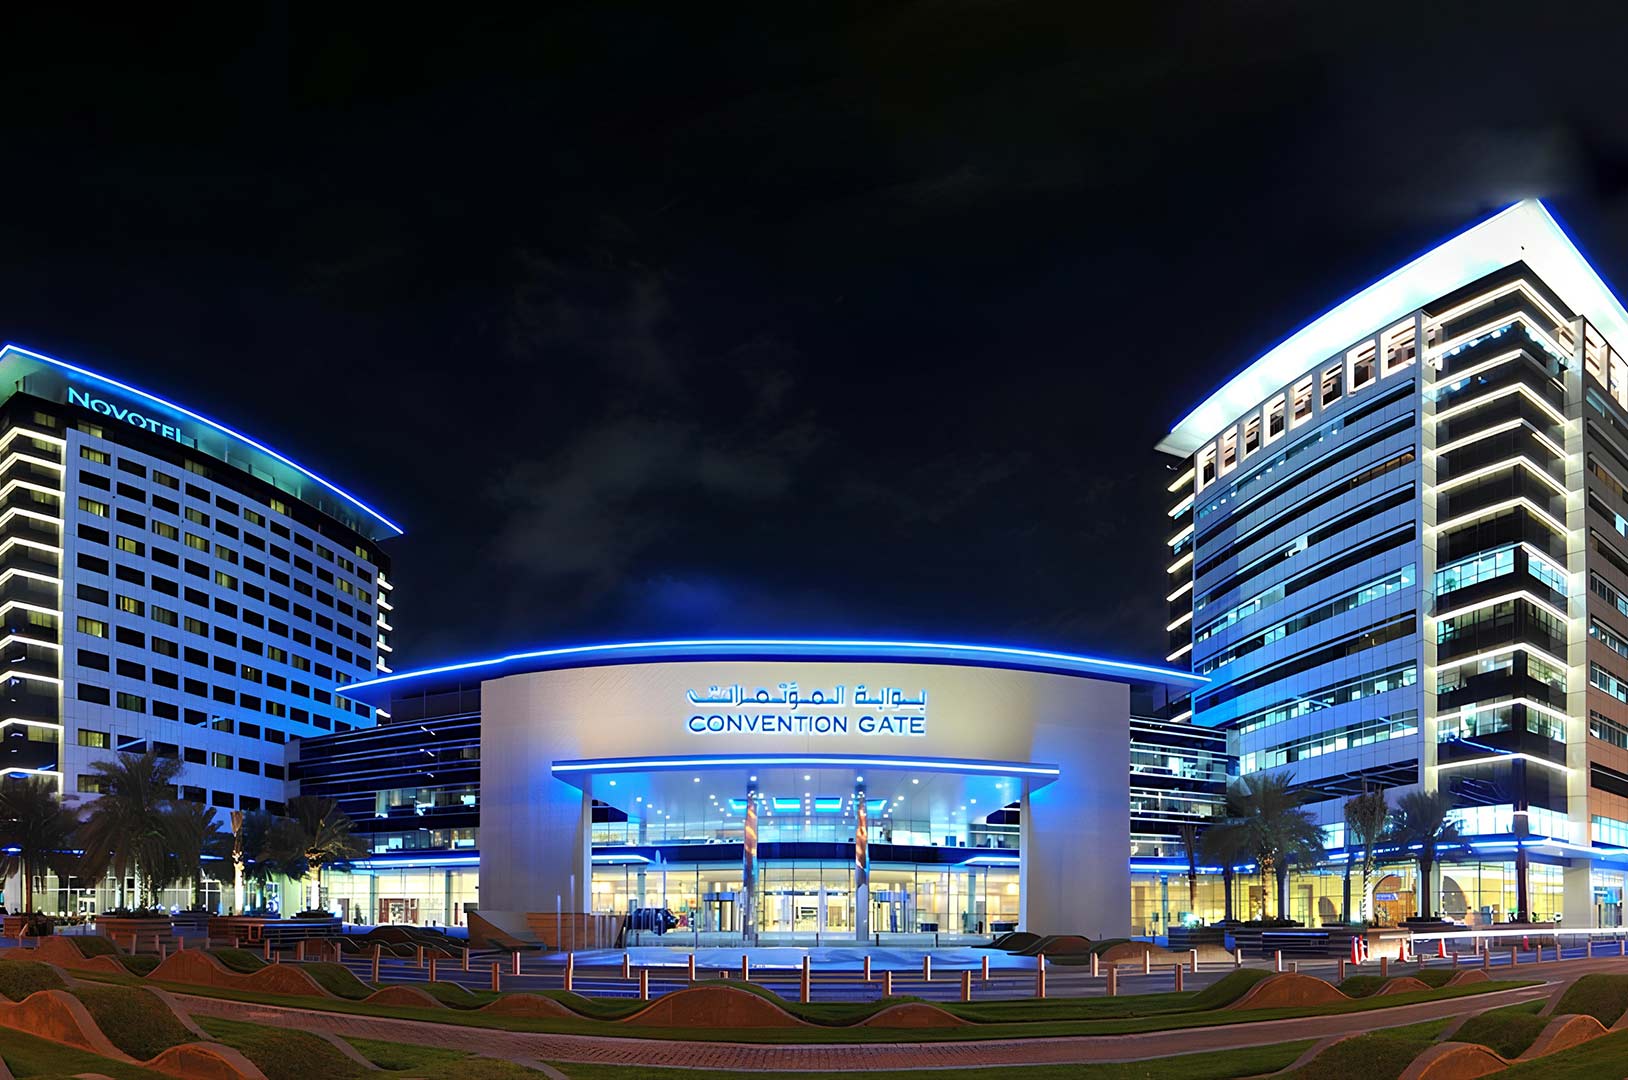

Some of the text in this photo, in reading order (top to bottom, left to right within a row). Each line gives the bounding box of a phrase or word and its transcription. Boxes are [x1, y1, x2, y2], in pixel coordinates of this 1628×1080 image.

[68, 386, 181, 443] NOVOTEL
[687, 682, 927, 711] بوابة المؤتمرات
[689, 714, 925, 733] CONVENTION GATE
